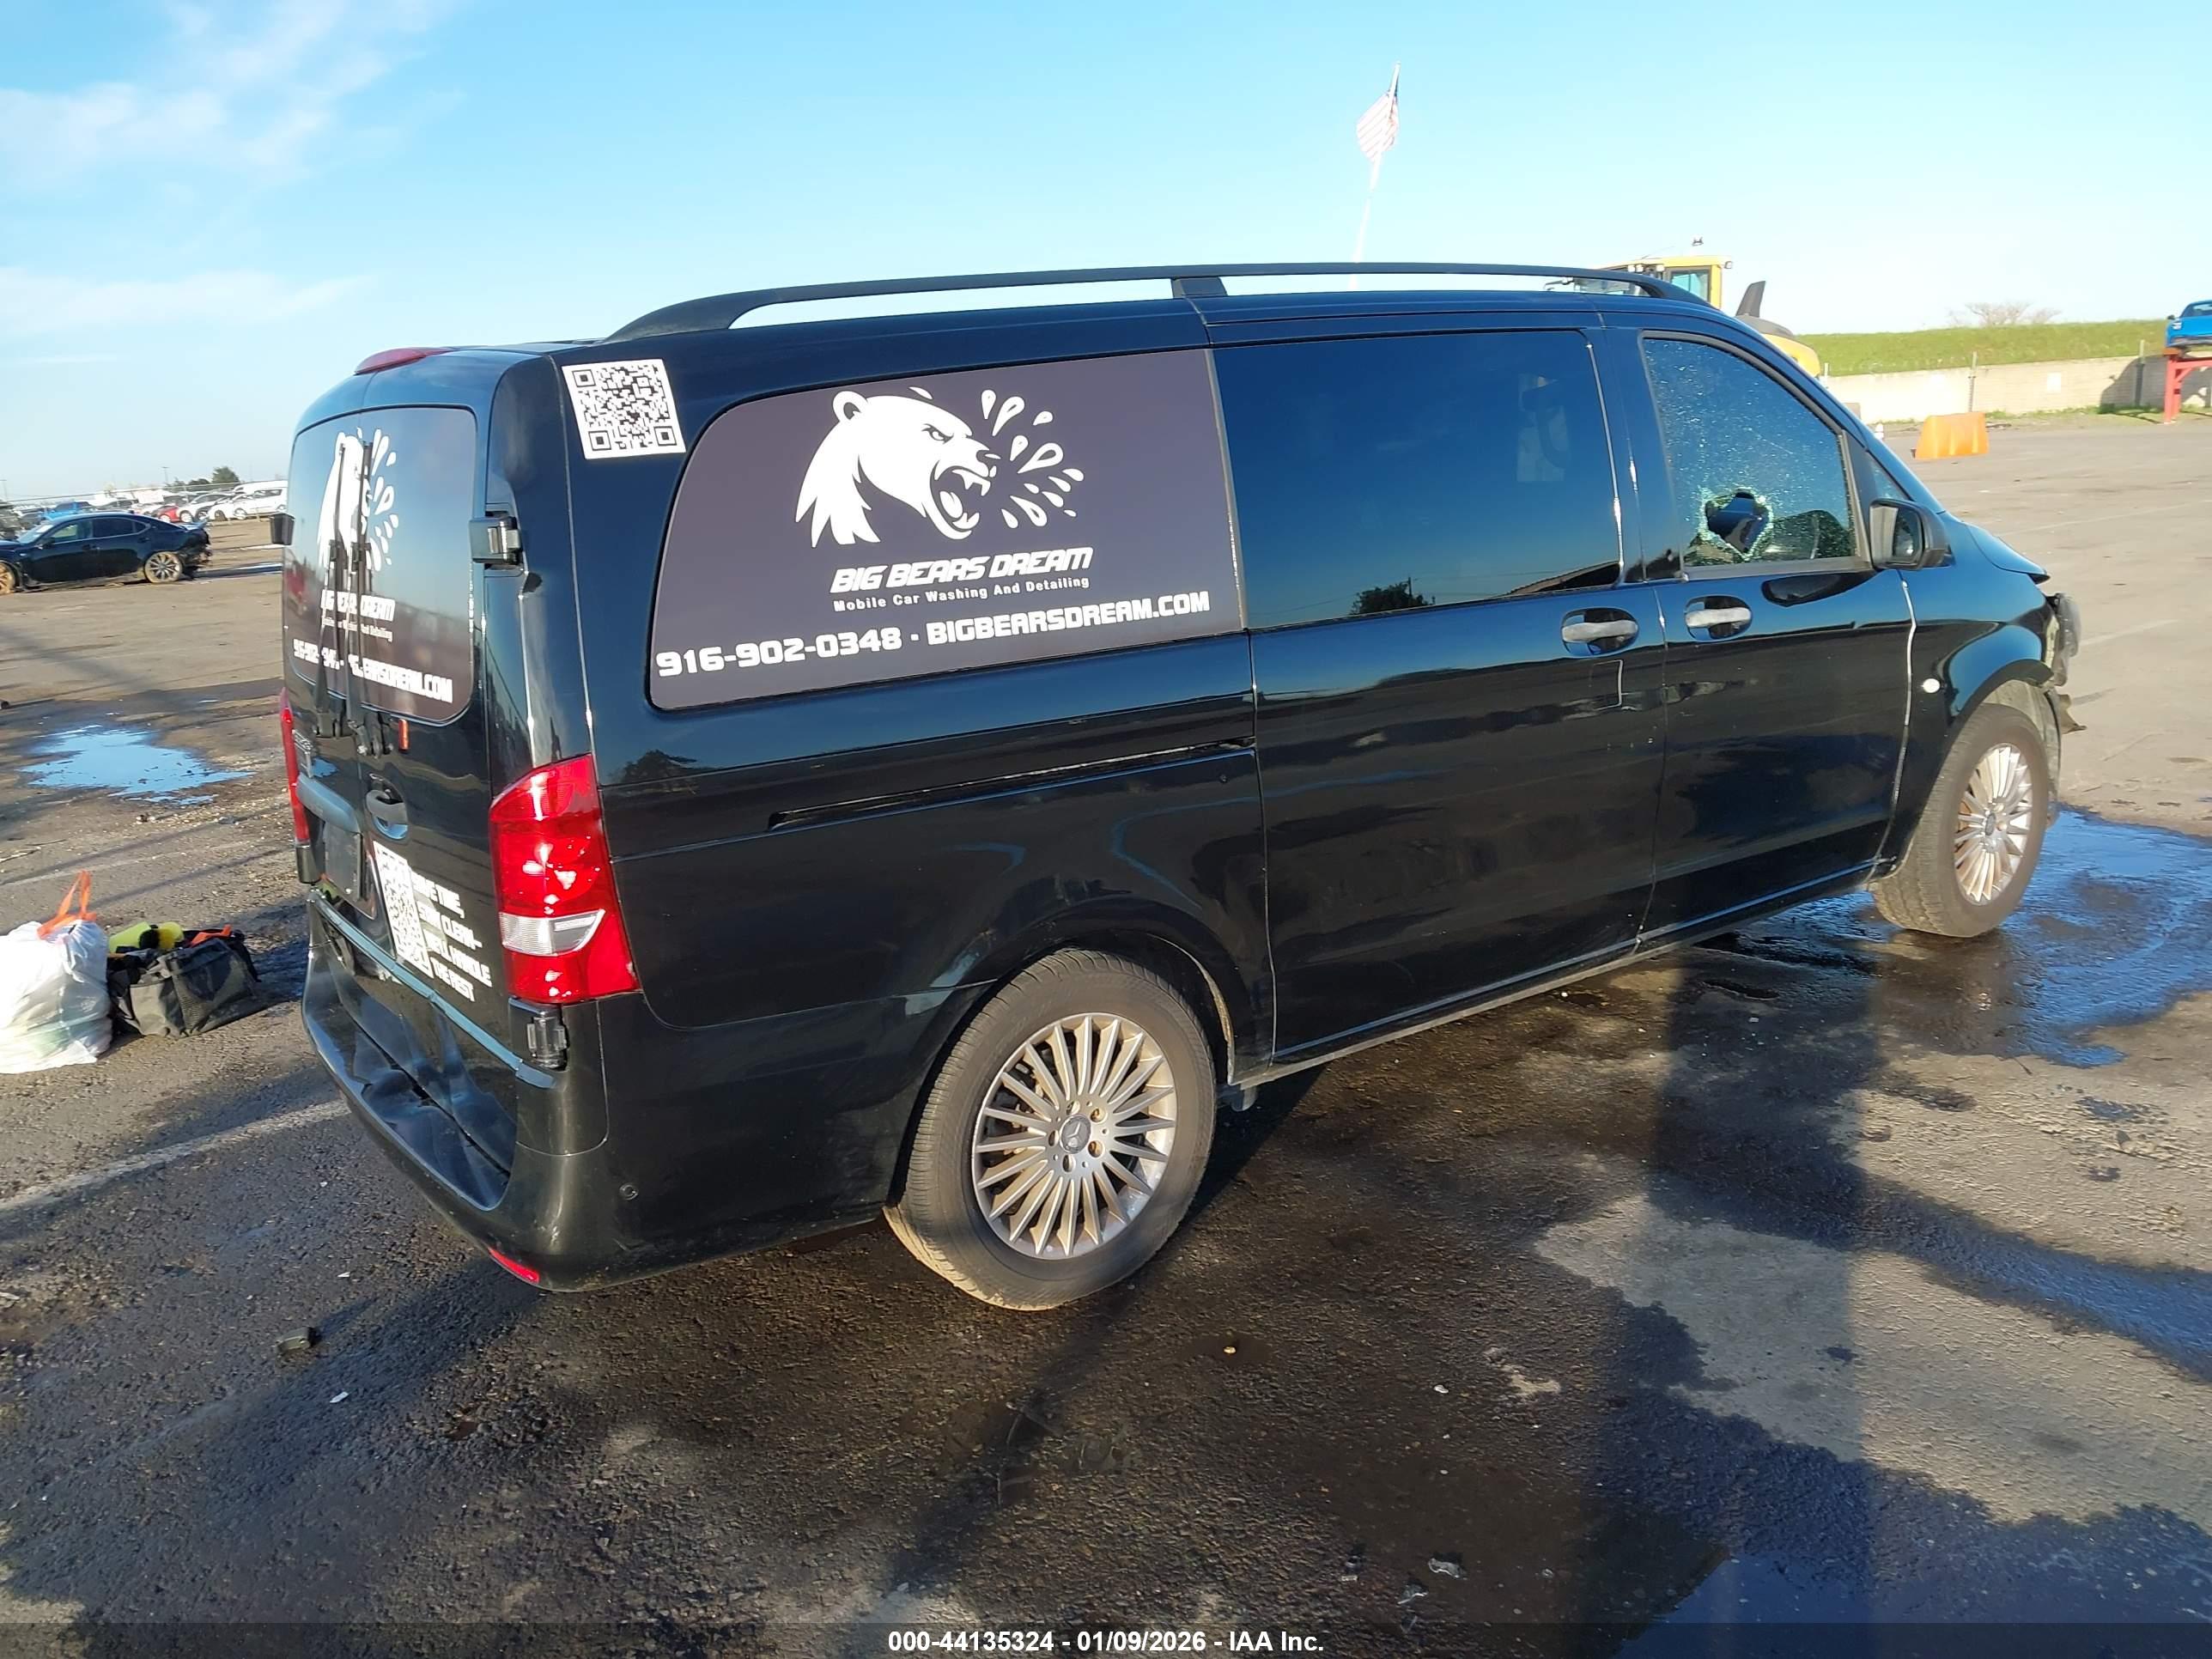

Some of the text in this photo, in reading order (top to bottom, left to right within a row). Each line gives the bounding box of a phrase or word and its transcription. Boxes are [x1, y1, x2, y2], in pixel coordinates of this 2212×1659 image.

[830, 546, 1094, 593] BIG BEARS DREAM
[833, 577, 1090, 612] Mobile Car Washing And Detailing
[656, 628, 902, 677] 916-902-0348
[926, 591, 1210, 646] BIGBEARSDREAM.COM
